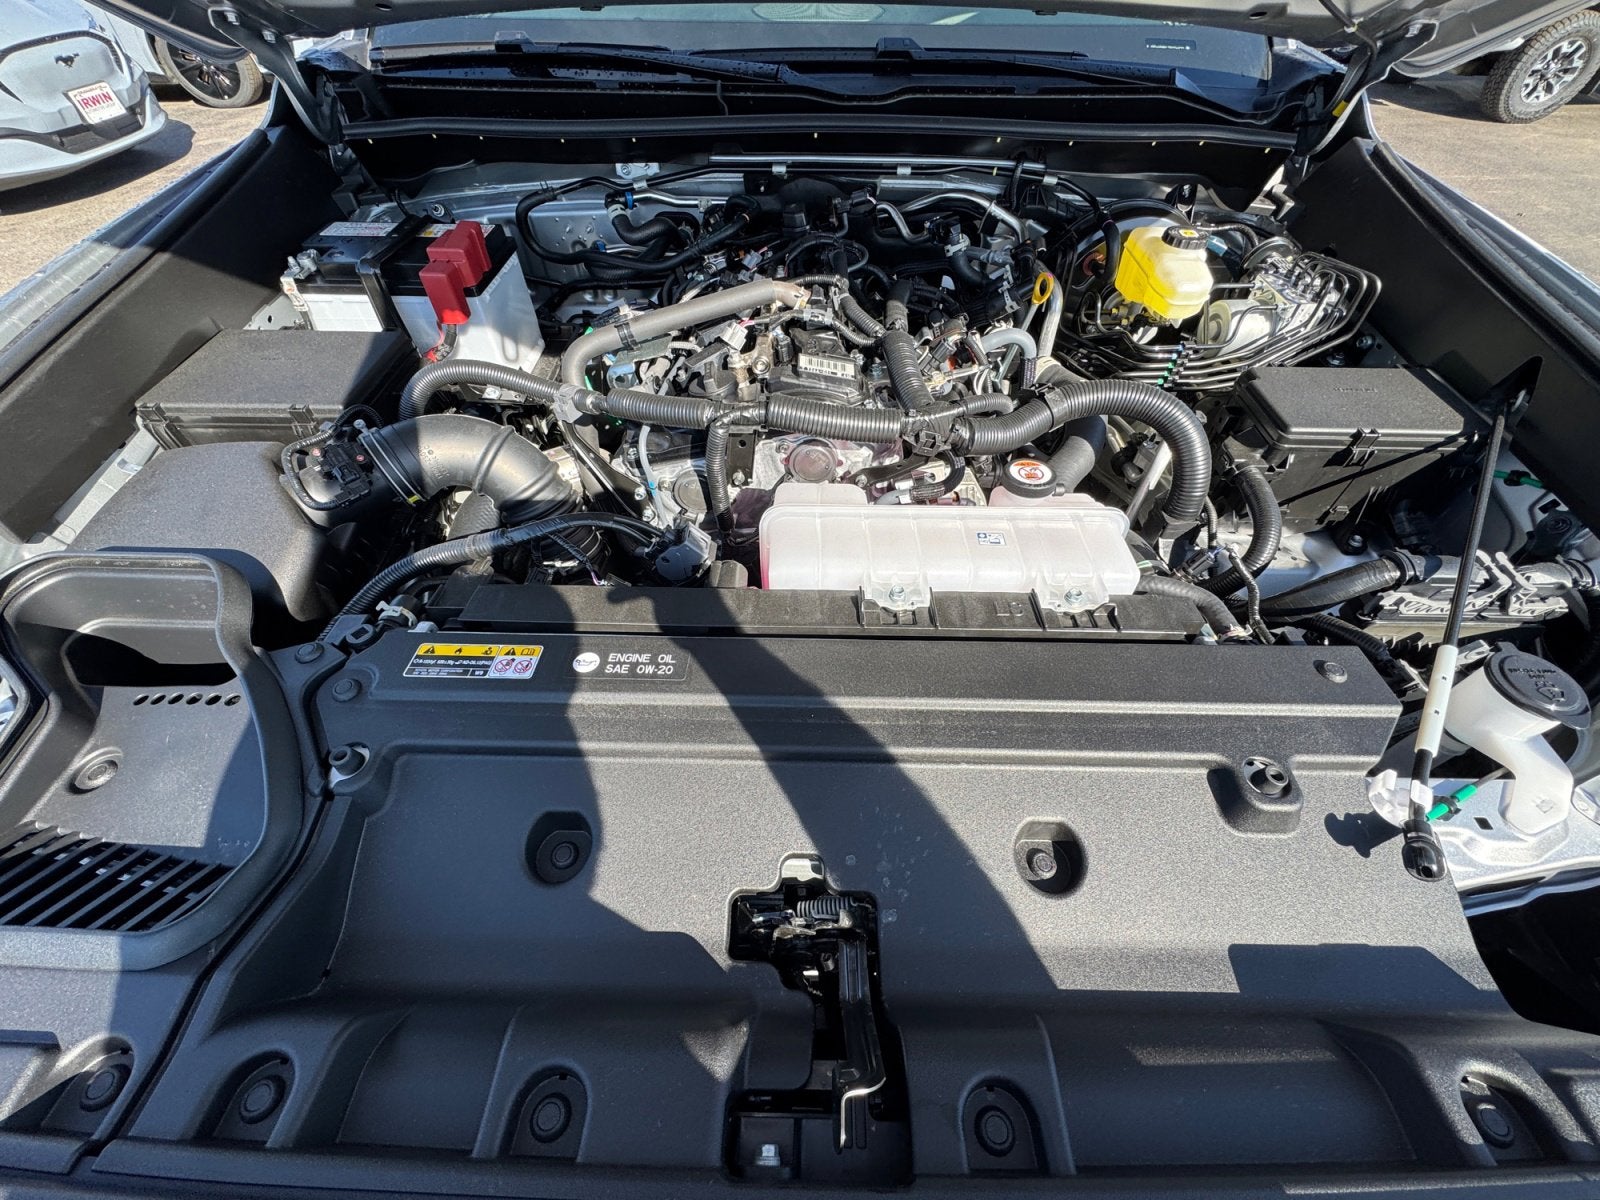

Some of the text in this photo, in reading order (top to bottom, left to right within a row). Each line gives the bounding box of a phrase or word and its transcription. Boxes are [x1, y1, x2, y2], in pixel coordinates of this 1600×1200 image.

[77, 91, 113, 110] IRWIN
[608, 653, 676, 663] ENGINE OIL
[605, 664, 673, 674] SAE 0W-20
